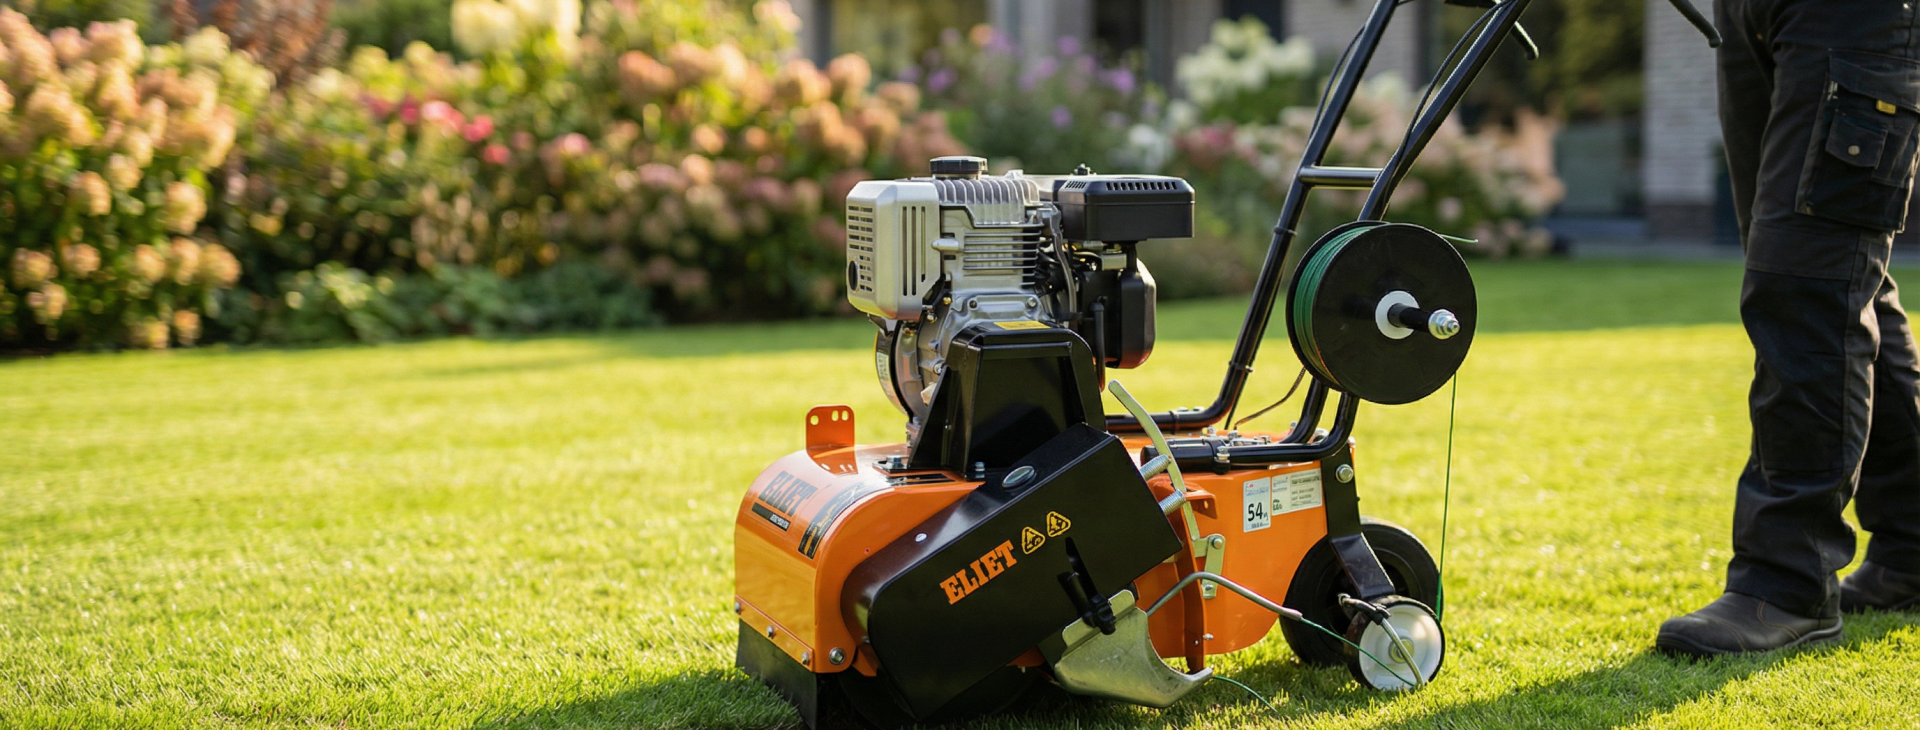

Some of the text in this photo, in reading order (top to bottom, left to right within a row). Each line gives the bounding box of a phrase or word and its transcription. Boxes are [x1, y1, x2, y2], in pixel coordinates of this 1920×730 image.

[758, 470, 818, 517] ELIET
[1248, 502, 1263, 522] 54
[939, 540, 1018, 605] ELIET
